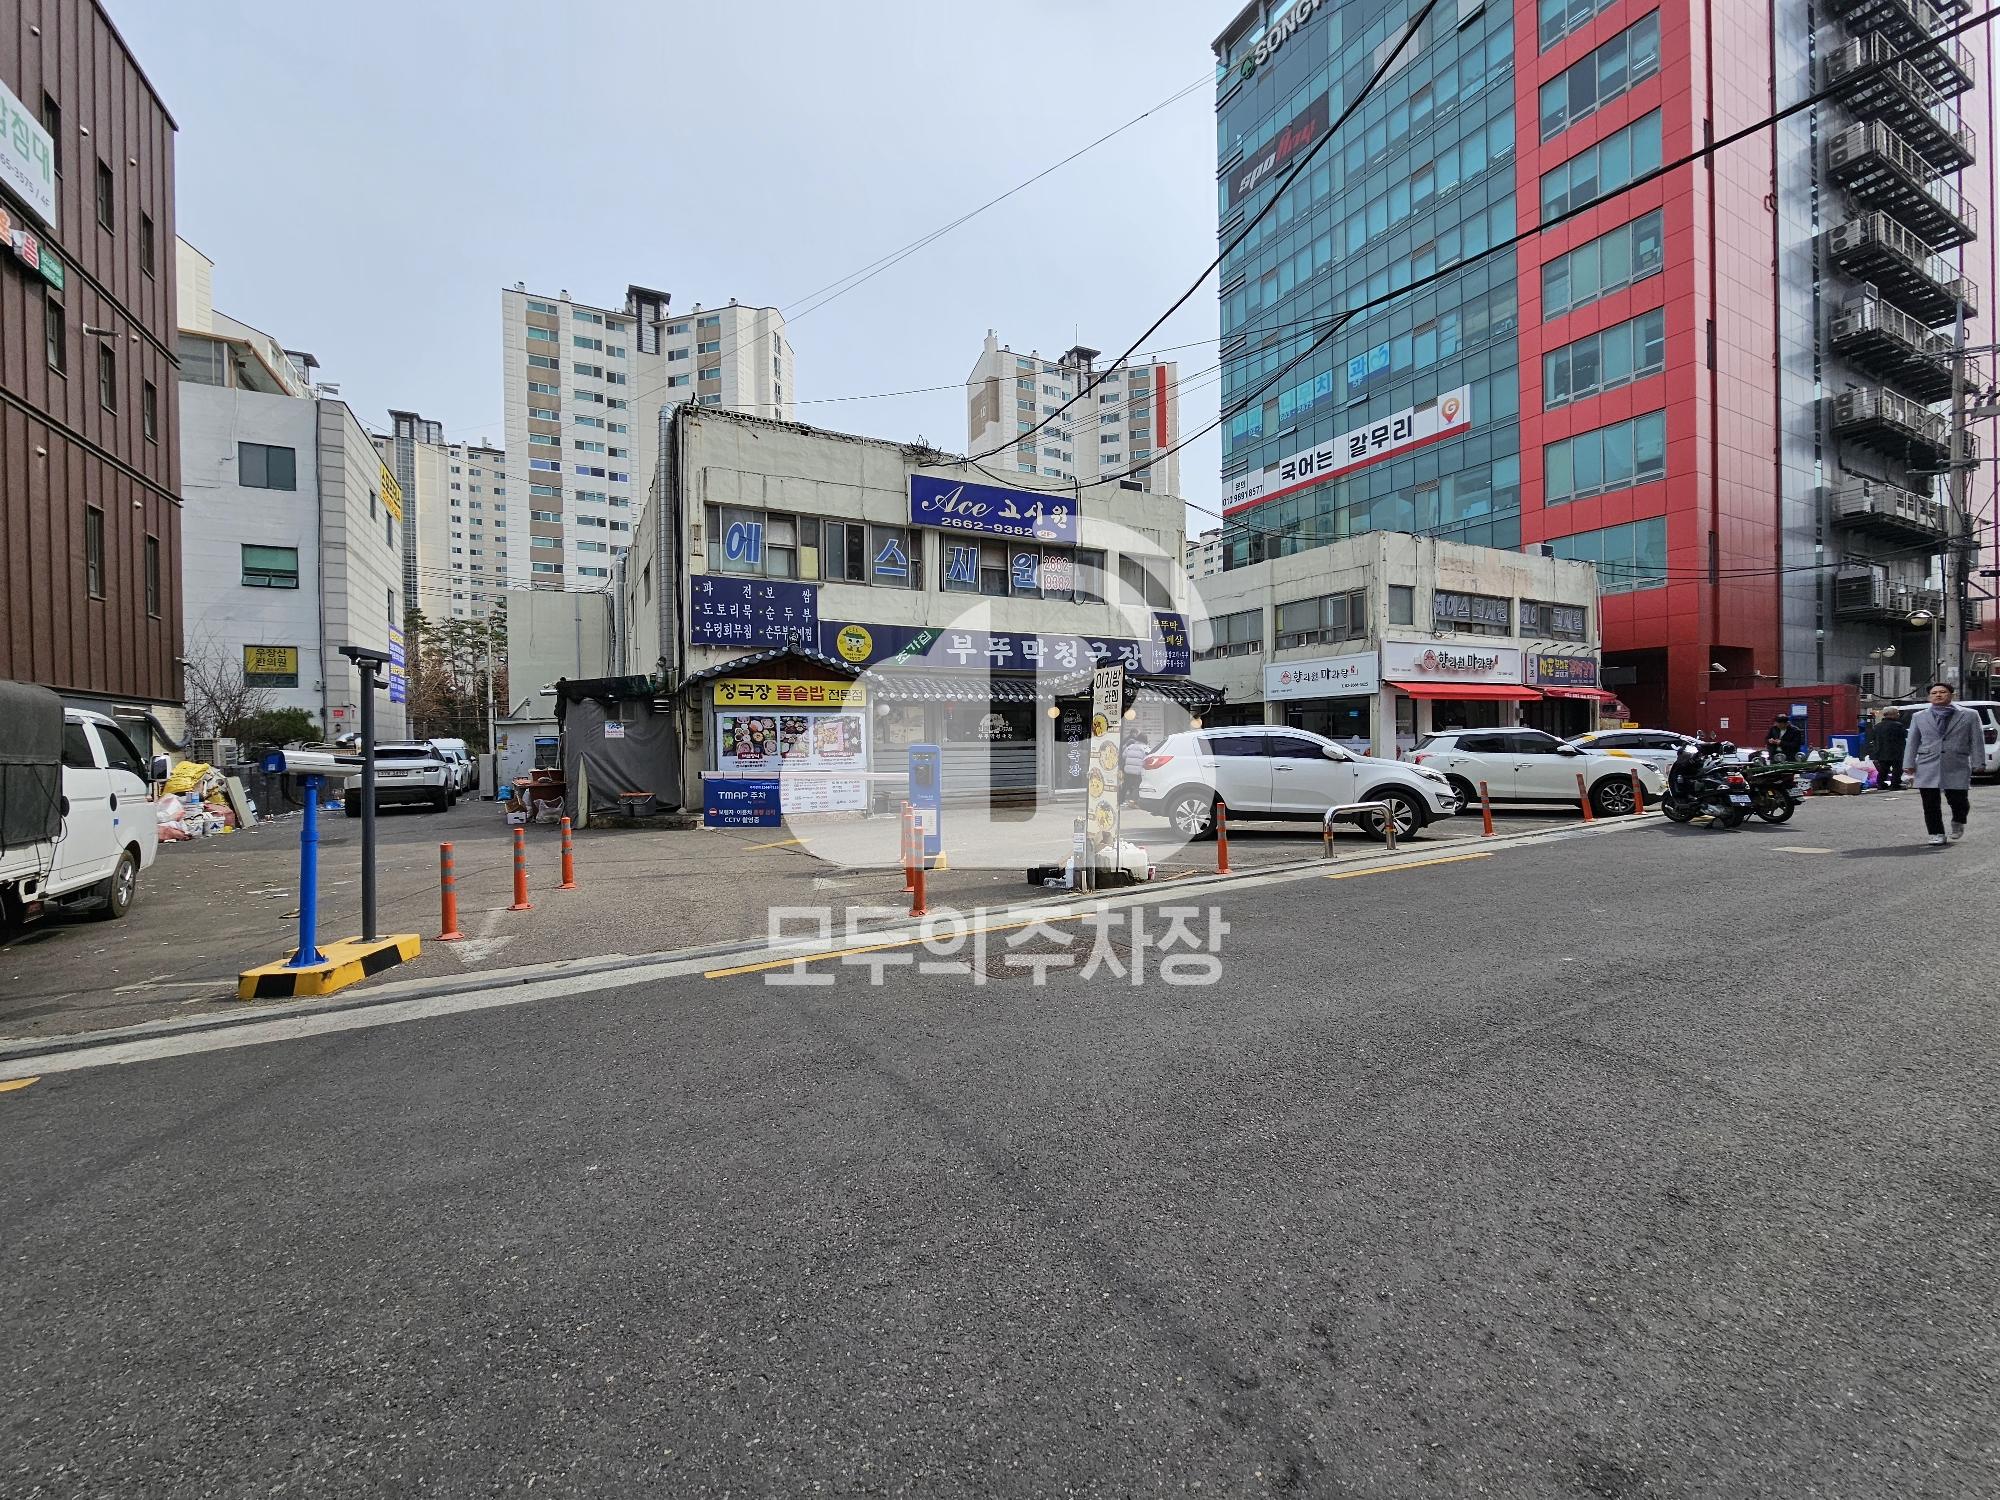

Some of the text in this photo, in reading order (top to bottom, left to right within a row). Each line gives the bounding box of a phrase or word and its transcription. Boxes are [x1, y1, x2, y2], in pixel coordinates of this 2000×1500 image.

[1281, 414, 1412, 480] 국어는 갈무리
[921, 485, 1069, 529] Ace 고시원
[941, 517, 1033, 537] 2662-9382
[702, 602, 753, 620] 도토리묵
[702, 621, 752, 639] 우렁회무침
[255, 648, 287, 658] 우장산
[255, 657, 287, 667] 한의원
[719, 682, 863, 702] 청국장 돌솥밥 전문점
[717, 791, 767, 800] TMAP 주차
